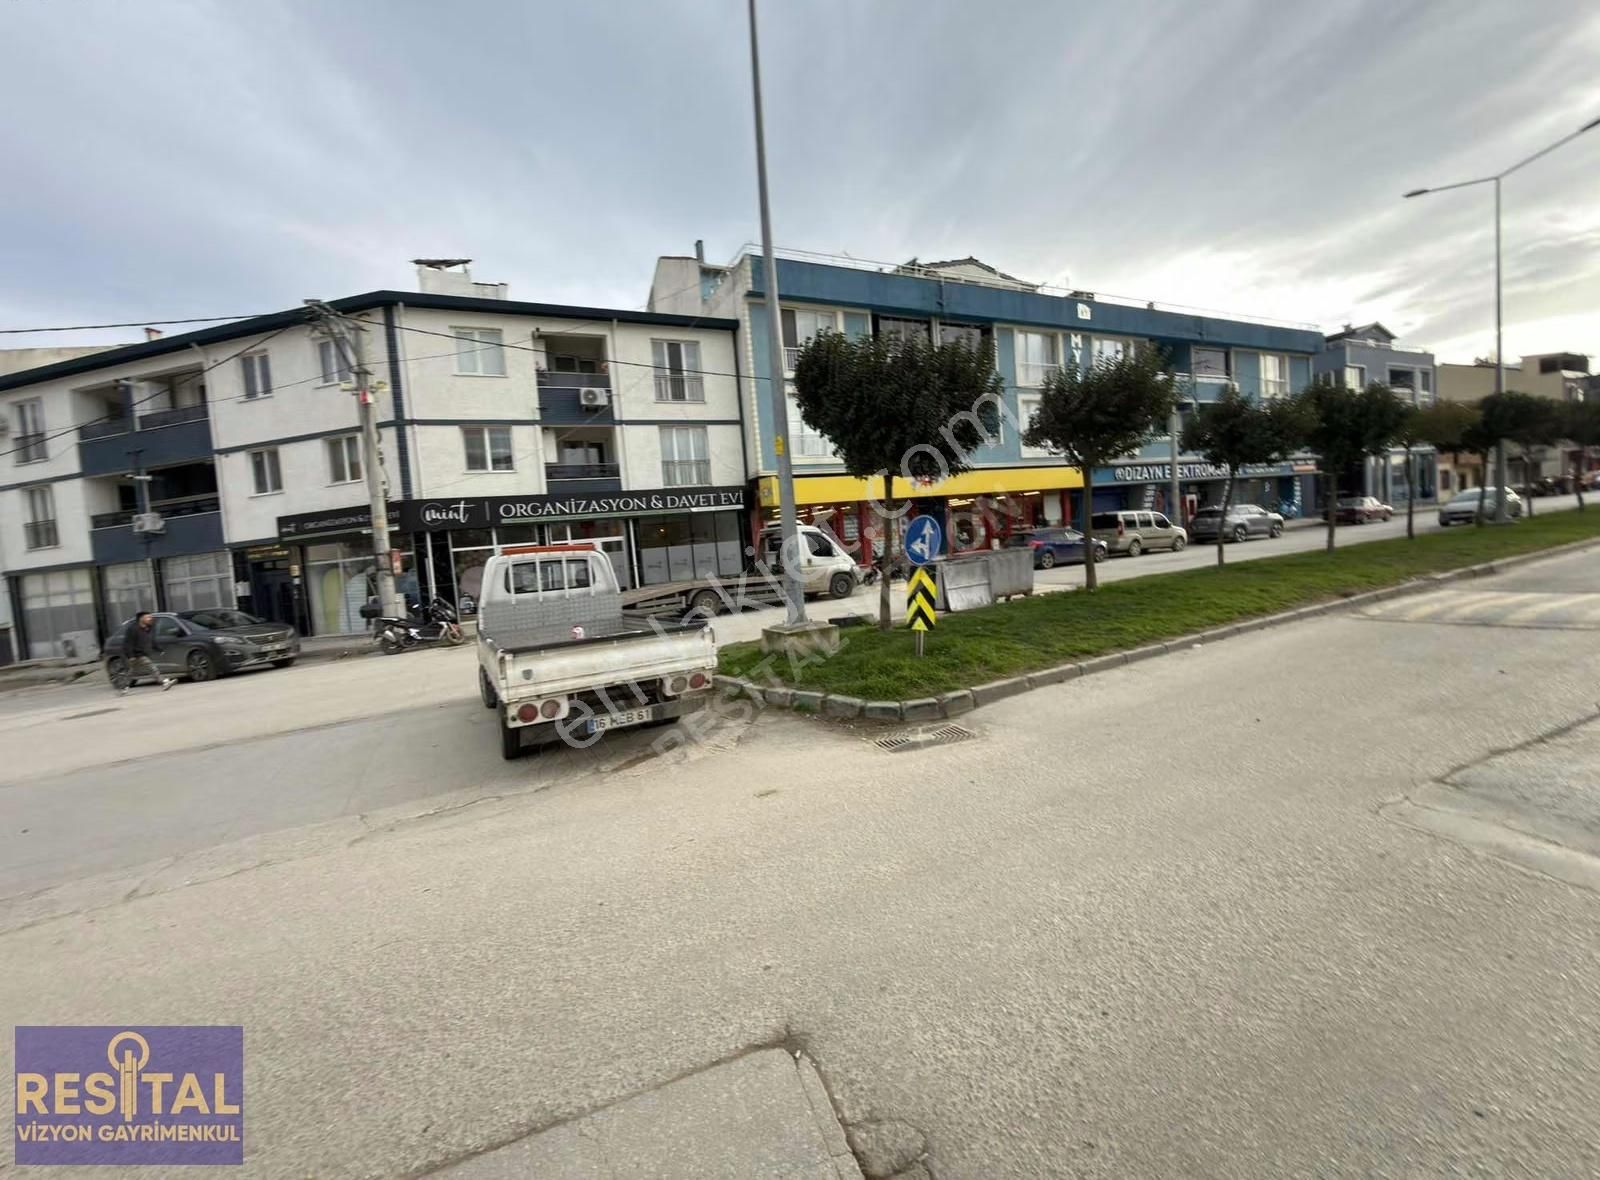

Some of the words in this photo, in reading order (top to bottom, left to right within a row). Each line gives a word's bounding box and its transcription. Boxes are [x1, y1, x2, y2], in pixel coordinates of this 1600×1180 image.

[424, 500, 476, 524] mint
[500, 497, 648, 518] ORGANİZASYON
[650, 494, 664, 509] &
[667, 493, 716, 508] DAVET
[721, 489, 745, 505] EVİ
